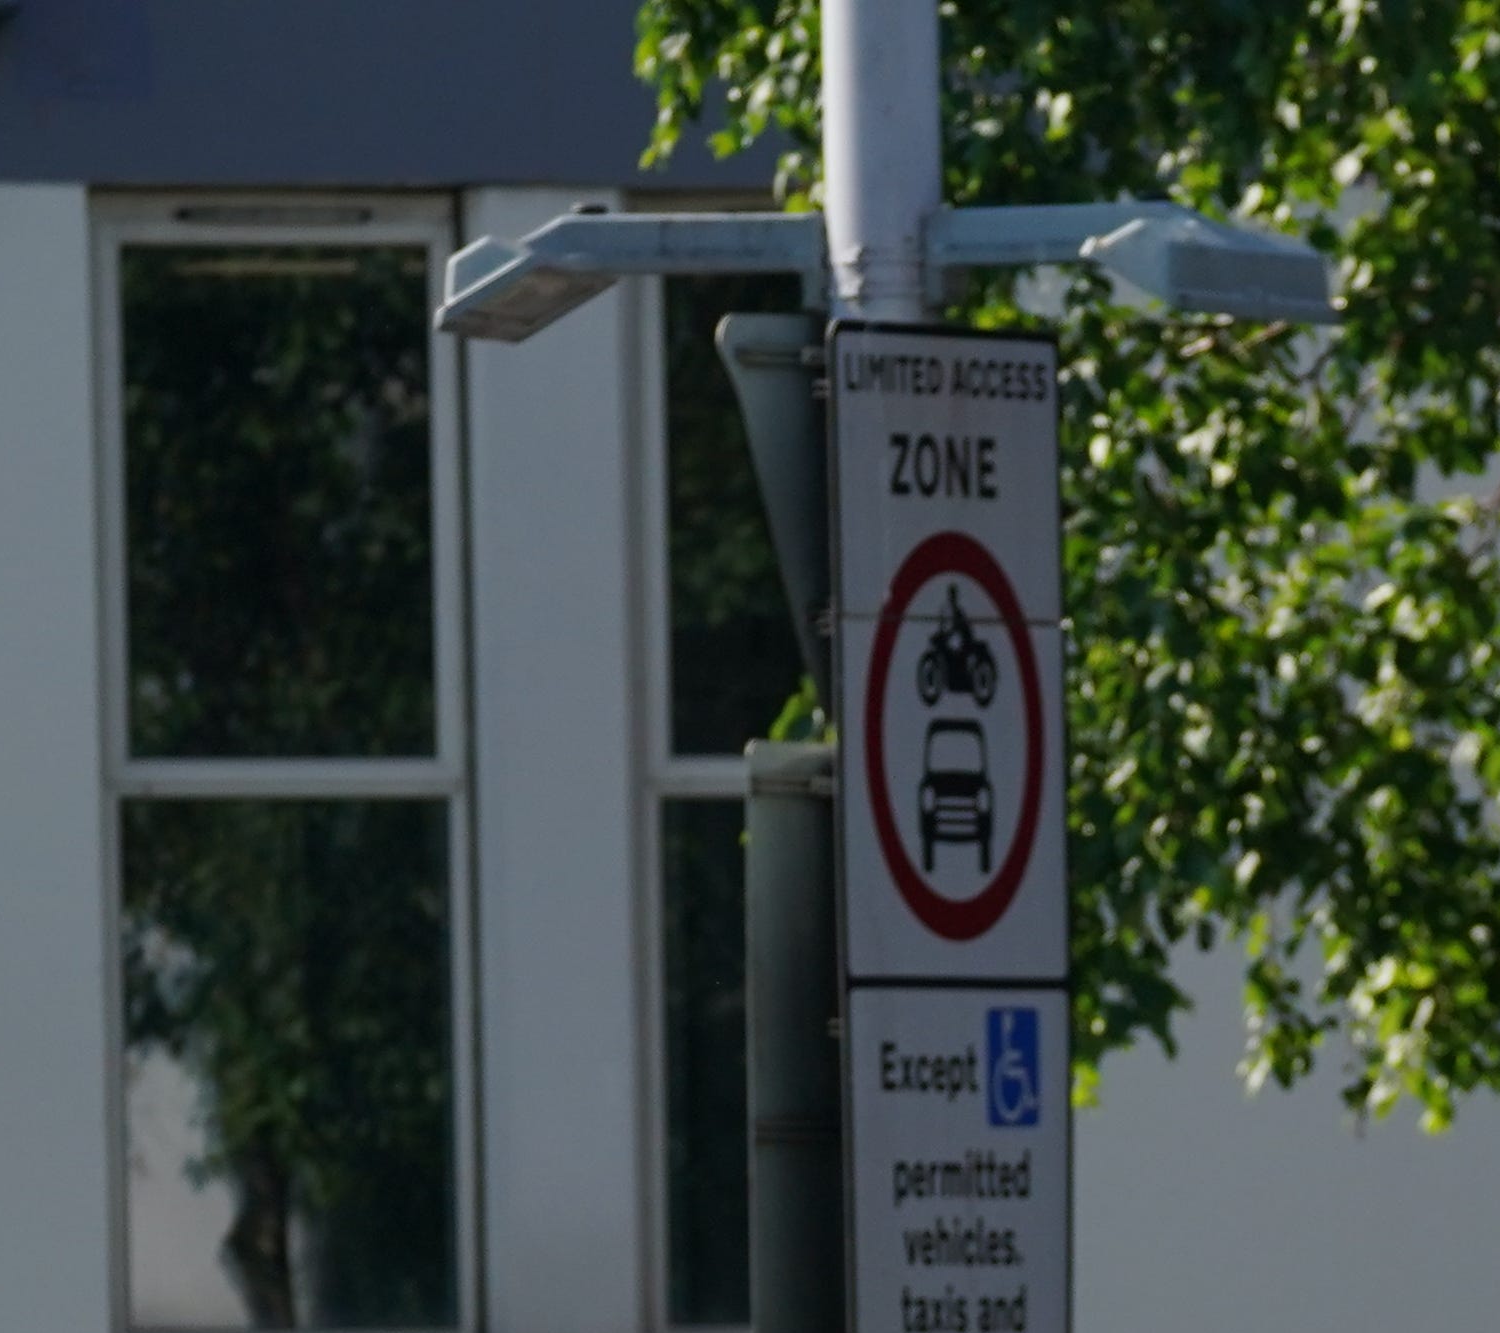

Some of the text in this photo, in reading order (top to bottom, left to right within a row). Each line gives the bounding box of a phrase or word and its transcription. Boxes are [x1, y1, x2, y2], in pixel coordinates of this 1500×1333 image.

[845, 351, 1049, 402] LIMITED ACCESS
[889, 433, 999, 499] ZONE
[879, 1041, 979, 1103] Except
[892, 1150, 1032, 1208] permitted
[902, 1284, 1027, 1333] taxis and
